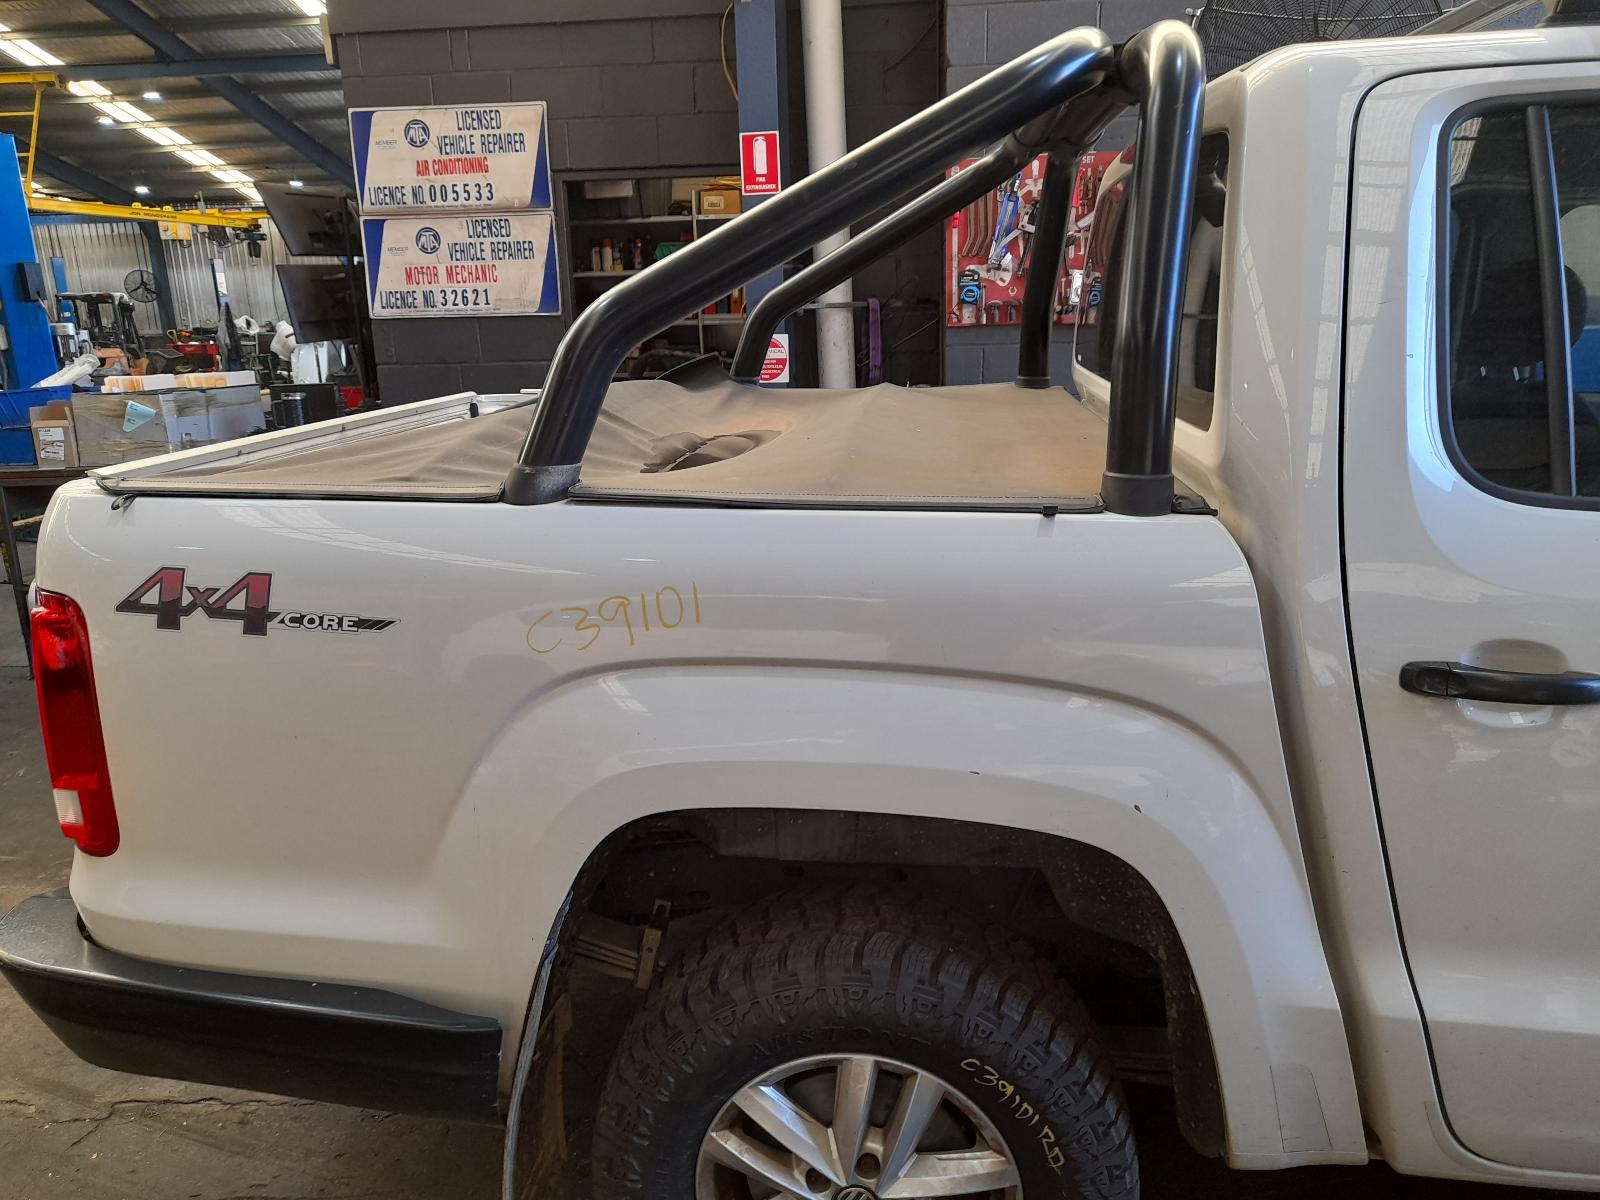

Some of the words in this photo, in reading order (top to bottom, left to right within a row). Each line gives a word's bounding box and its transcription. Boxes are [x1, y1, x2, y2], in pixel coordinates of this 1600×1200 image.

[455, 109, 502, 131] LICENSED
[436, 134, 475, 156] VEHICLE
[480, 132, 526, 155] REPAIRER
[416, 159, 431, 177] AIR
[432, 156, 490, 176] CONDITIONING
[368, 186, 407, 206] LICENCE
[411, 184, 427, 205] NO.
[429, 182, 495, 203] 005533
[466, 218, 512, 239] LICENSED
[447, 242, 486, 262] VEHICLE
[490, 240, 535, 261] REPAIRER
[404, 266, 440, 286] MOTOR
[446, 263, 498, 285] MECHANIC
[379, 290, 418, 310] LICENCE
[422, 289, 438, 309] NO.
[439, 288, 492, 307] 32621
[283, 611, 360, 633] CORE
[526, 580, 702, 654] C39101
